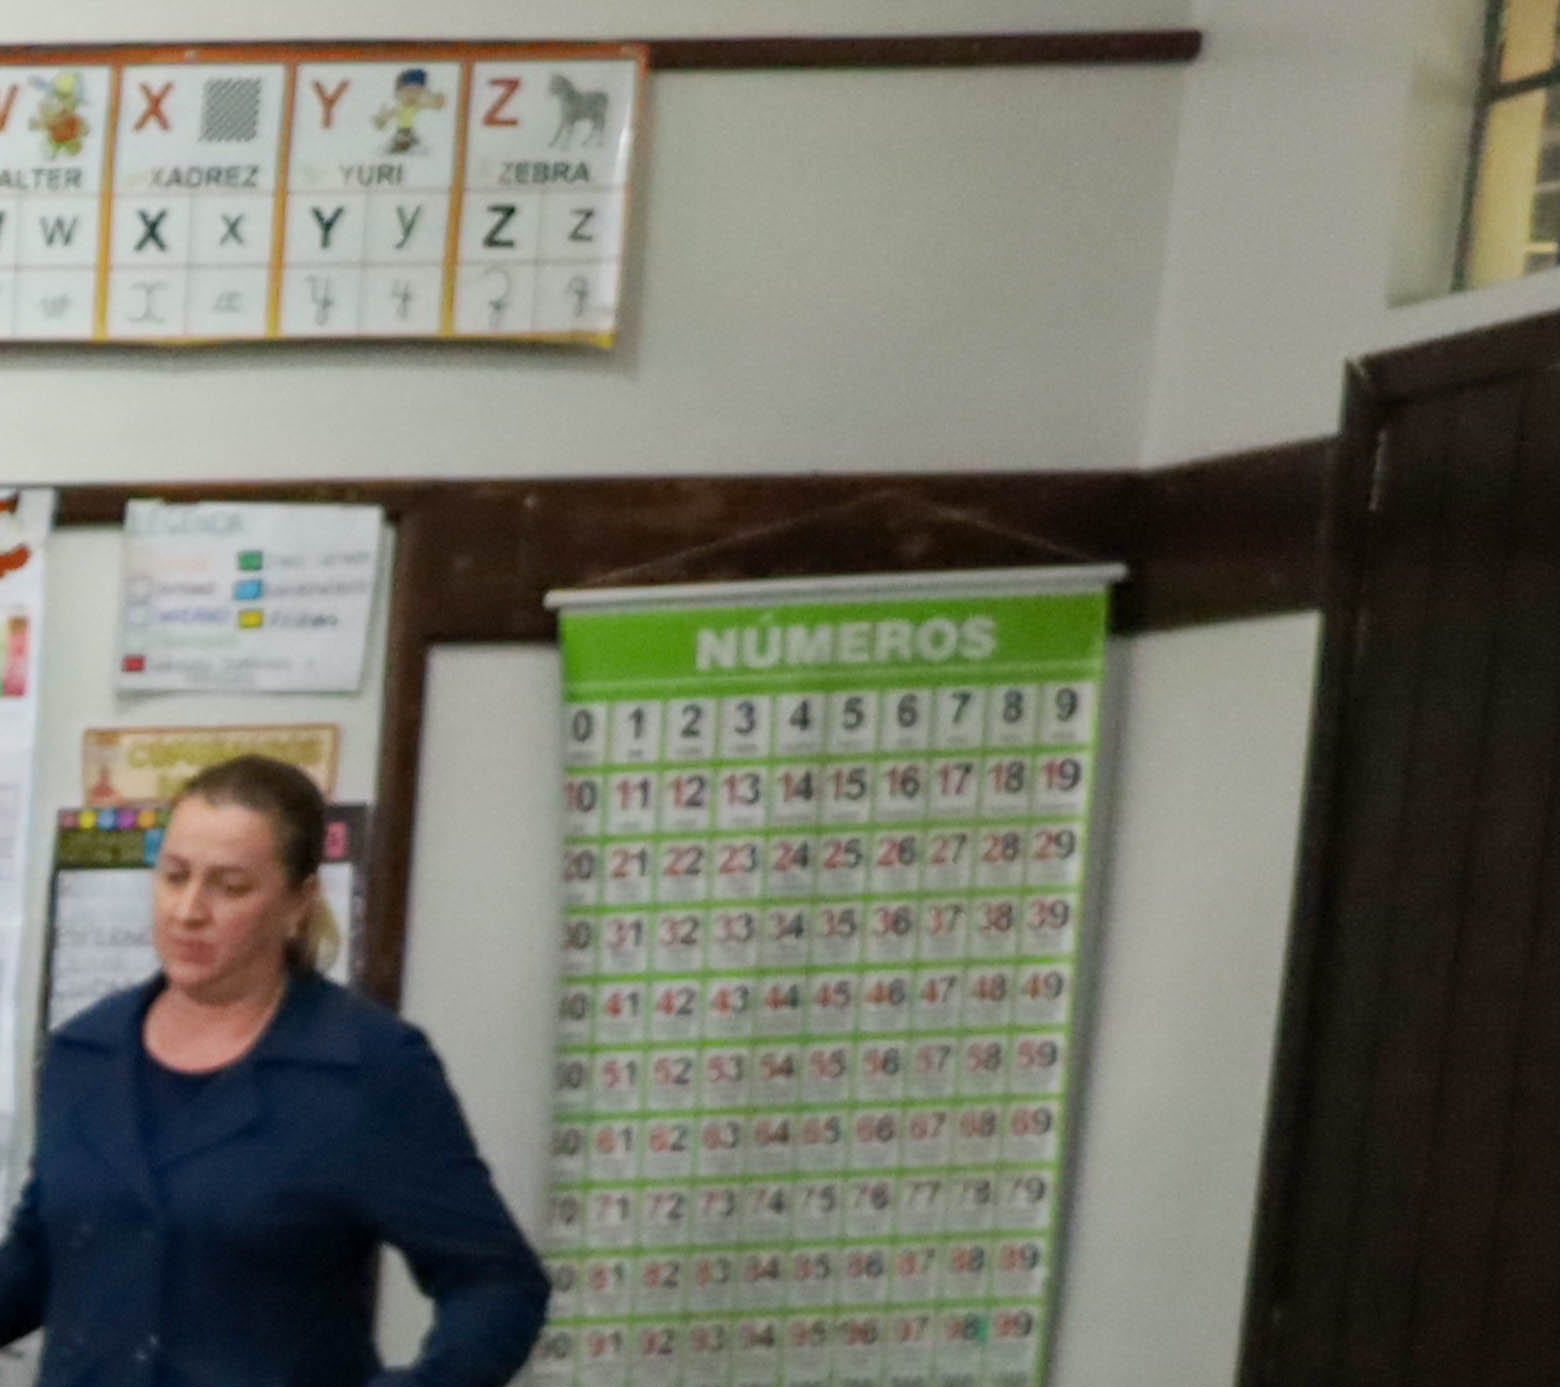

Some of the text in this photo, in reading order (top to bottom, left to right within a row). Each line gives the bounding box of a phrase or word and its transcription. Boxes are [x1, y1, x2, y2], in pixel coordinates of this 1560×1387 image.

[135, 84, 173, 130] X
[313, 82, 350, 128] Y
[483, 80, 519, 127] Z
[499, 163, 589, 184] ZEBRA
[40, 216, 79, 246] w
[135, 209, 244, 250] X x
[311, 209, 418, 249] Y y
[483, 206, 593, 247] Z z
[696, 612, 997, 671] NÚMEROS
[572, 688, 1078, 742] 0 1 2 3 4 5 6 7 8 9
